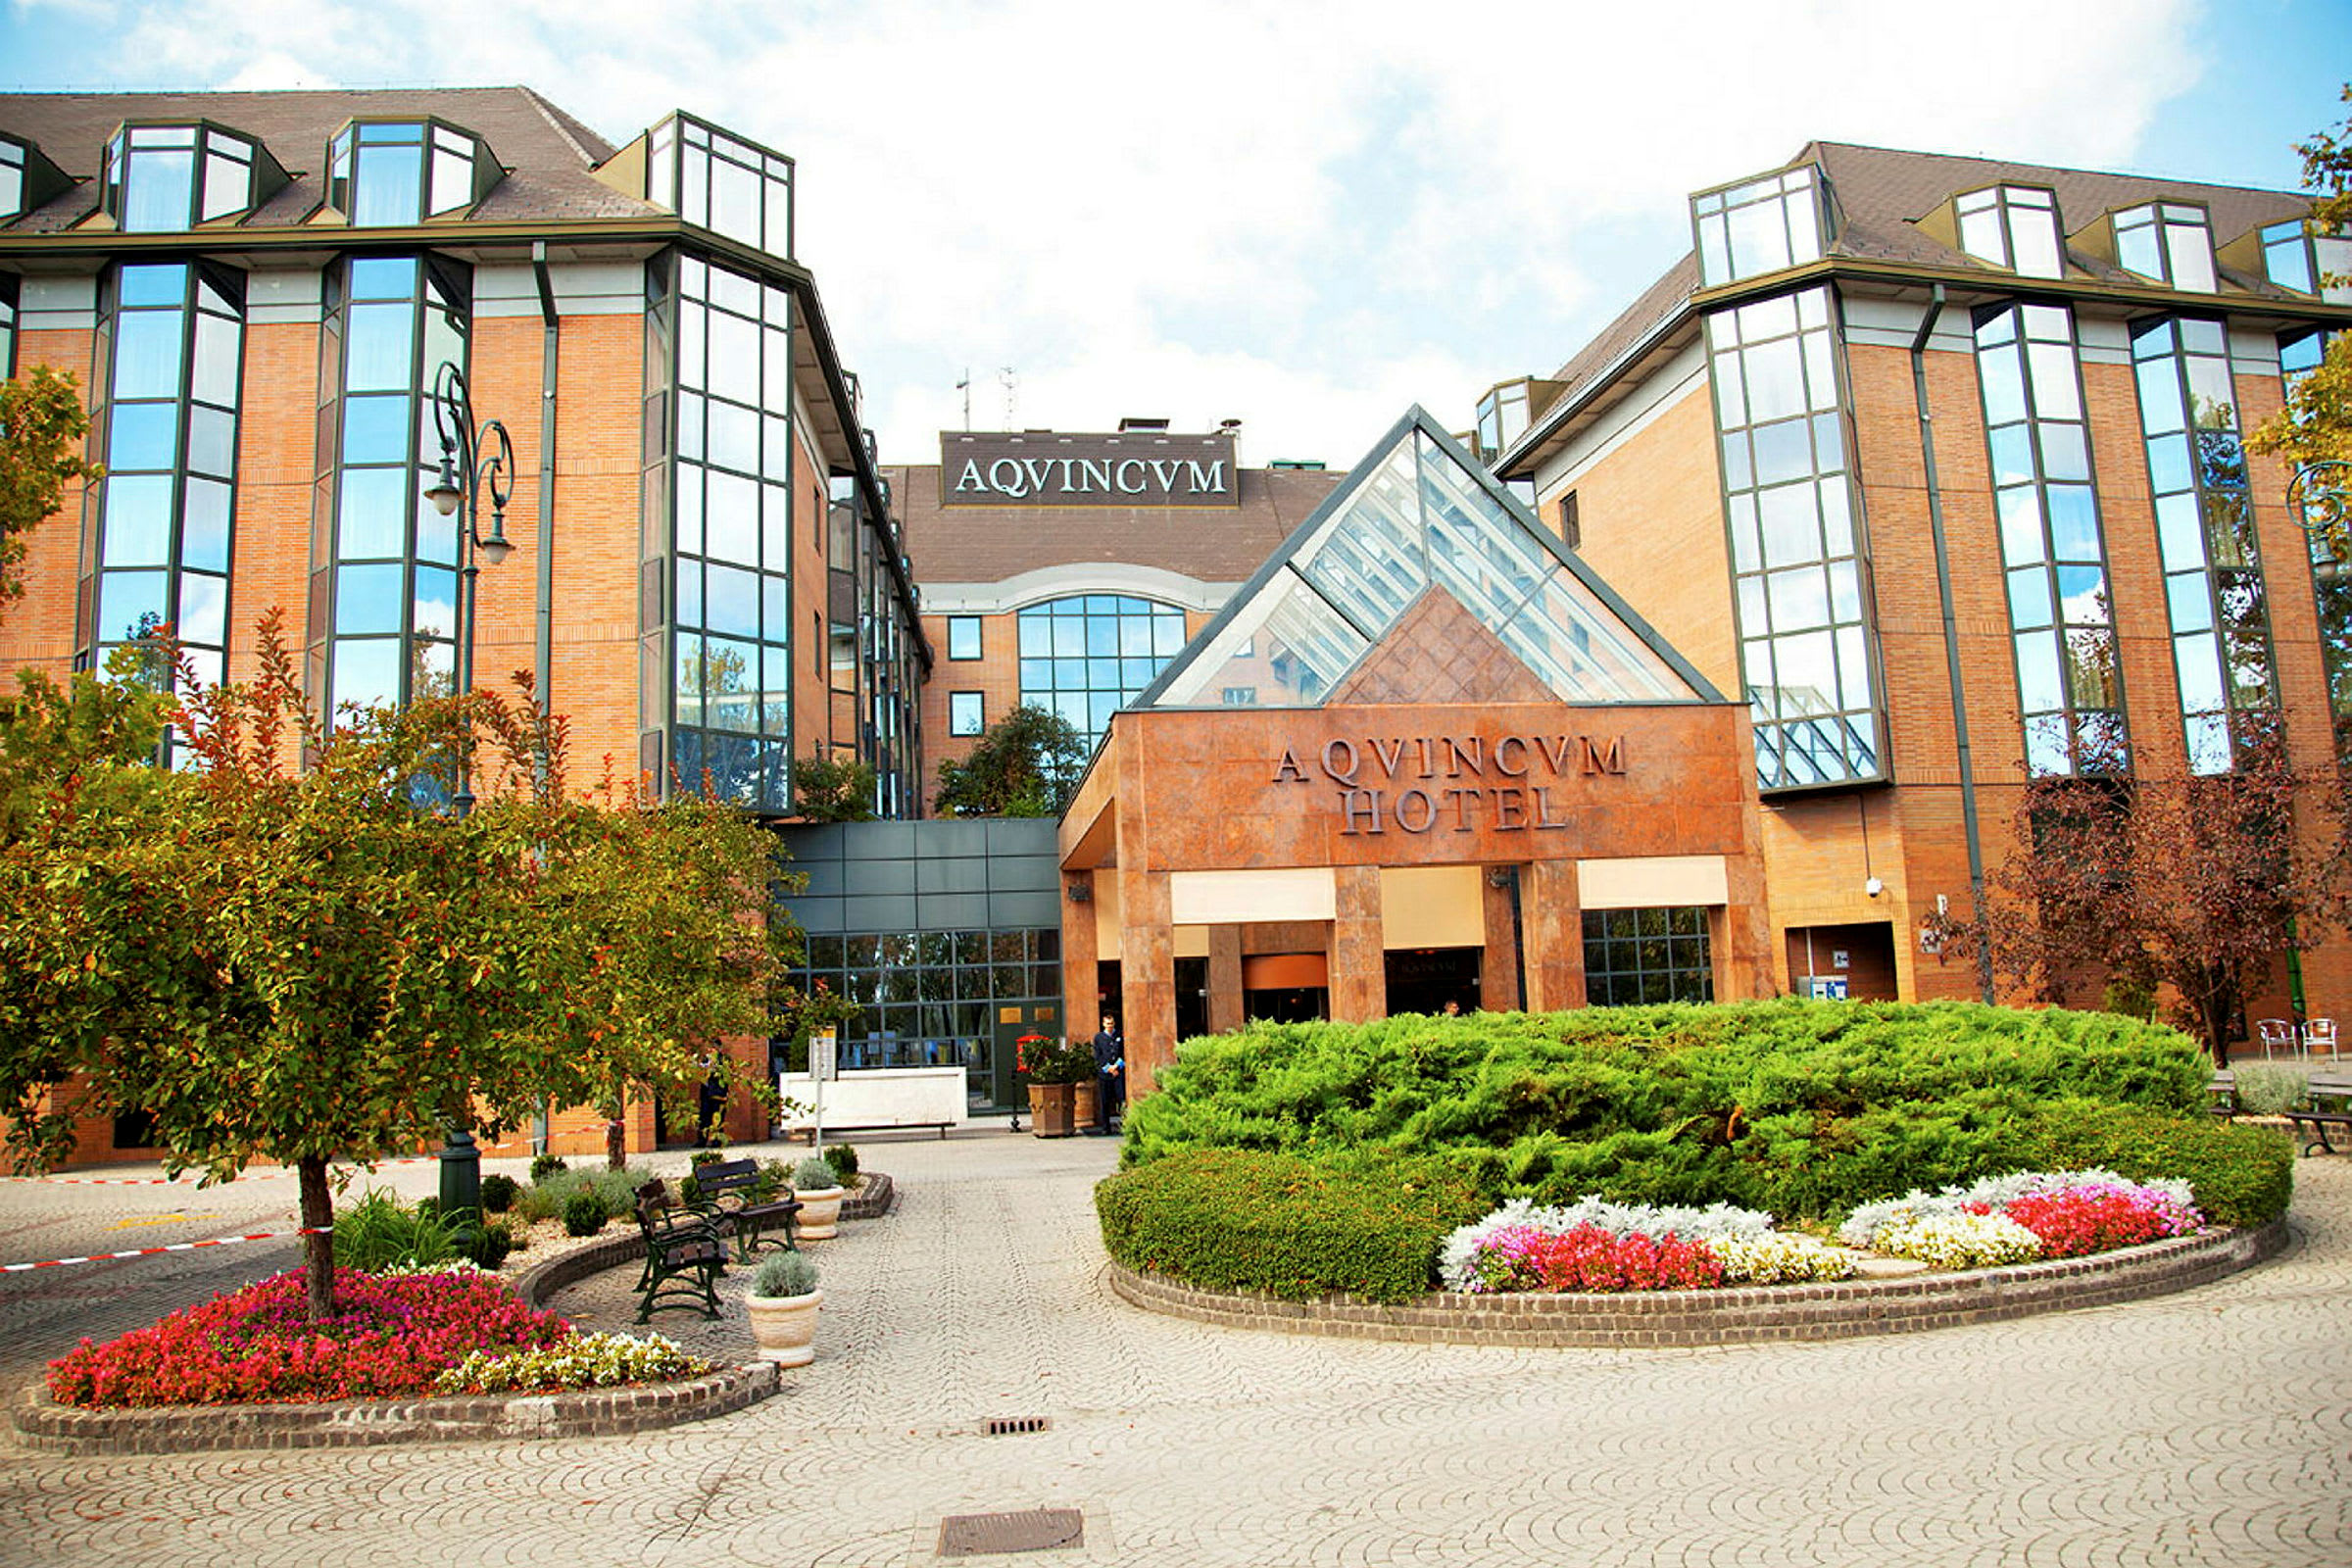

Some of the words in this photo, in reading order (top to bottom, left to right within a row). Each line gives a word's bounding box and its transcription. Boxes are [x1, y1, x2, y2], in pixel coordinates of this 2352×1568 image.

[956, 458, 1227, 498] AQVINCVM
[1272, 736, 1628, 787] AQVINCVM
[1339, 787, 1567, 835] HOTEL
